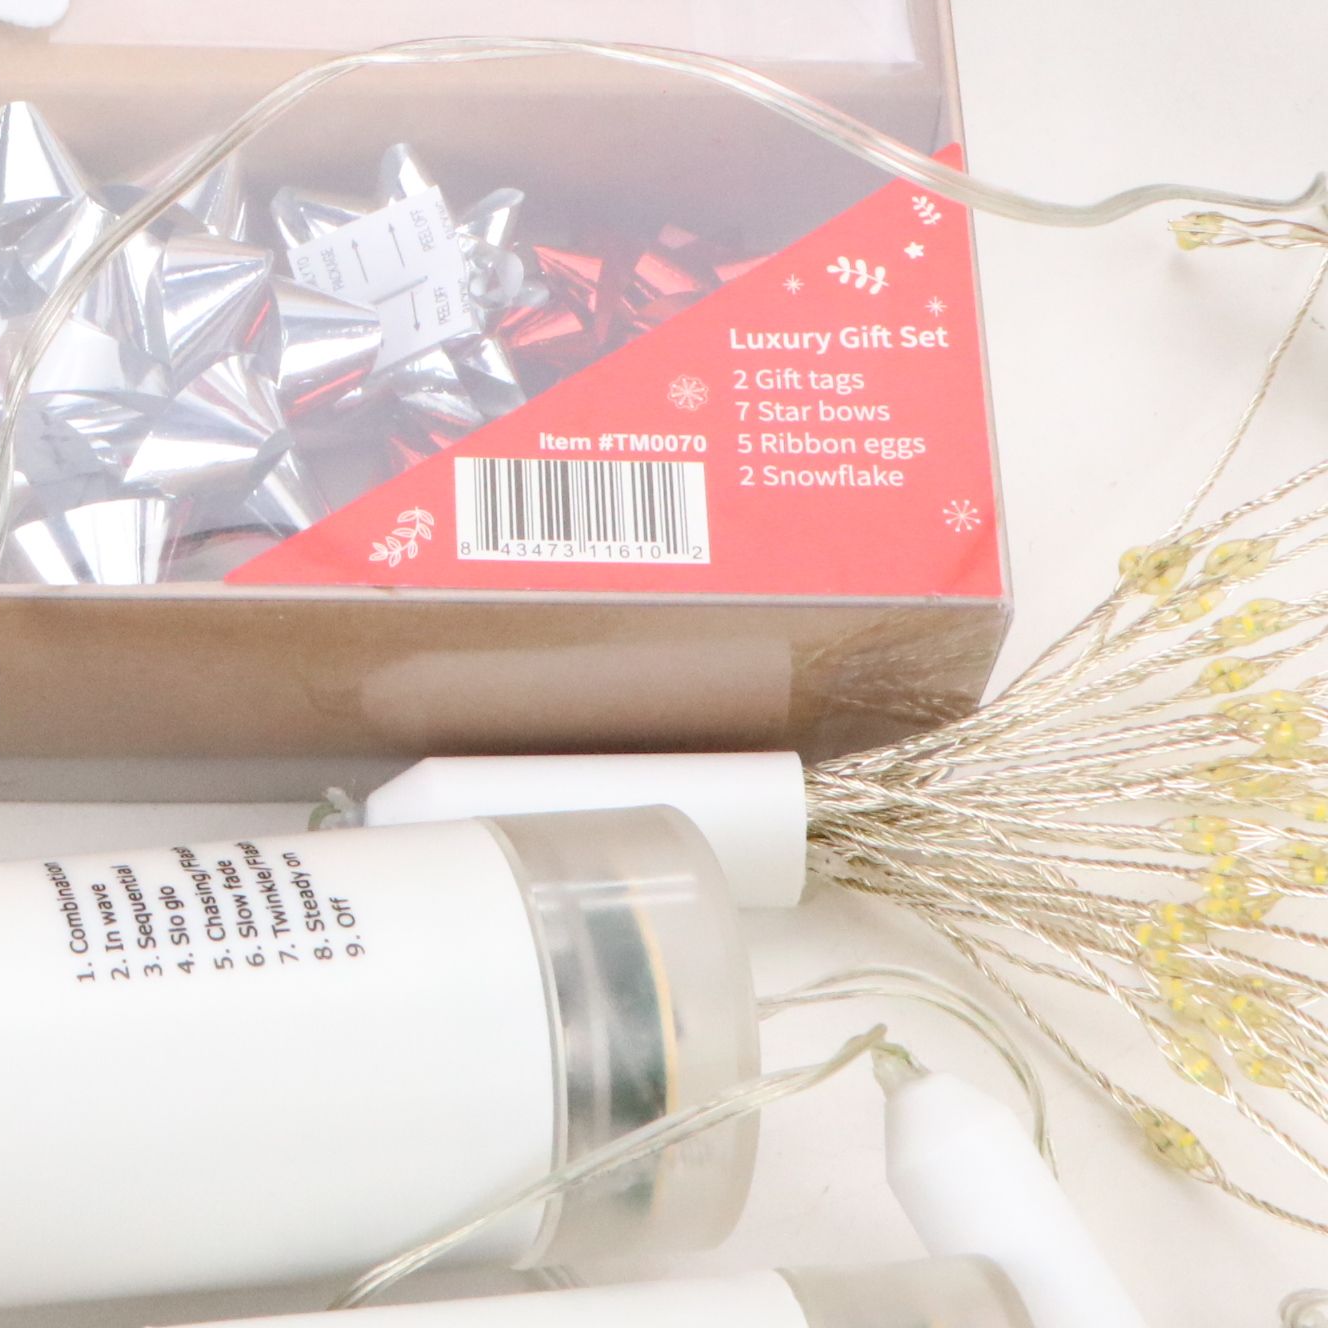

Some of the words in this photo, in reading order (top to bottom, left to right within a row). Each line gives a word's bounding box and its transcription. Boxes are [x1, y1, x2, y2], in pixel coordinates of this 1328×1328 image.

[729, 328, 832, 355] Luxury
[839, 324, 893, 349] Gift
[900, 325, 949, 348] Set
[733, 369, 749, 390] 2
[755, 368, 803, 390] Gift
[808, 370, 865, 395] tags
[735, 401, 751, 422] 7
[758, 401, 812, 422] Star
[819, 400, 891, 422] bows
[539, 432, 592, 450] Item
[598, 433, 707, 452] #TM0070
[737, 433, 753, 455] 5
[761, 432, 857, 454] Ribbon
[864, 436, 926, 460] eggs
[739, 465, 755, 486] 2
[763, 464, 904, 487] Snowflake
[461, 541, 472, 556] 8
[500, 542, 575, 558] 43473
[590, 544, 662, 560] 11610
[692, 545, 703, 560] 2
[282, 851, 301, 868] on
[216, 859, 243, 891] fade
[43, 862, 89, 954] Combination
[91, 882, 118, 926] wave
[110, 864, 157, 950] Sequential
[158, 885, 185, 911] glo
[291, 871, 325, 932] Steady
[232, 894, 258, 939] Slow
[329, 896, 356, 928] Off
[105, 930, 124, 952] In
[169, 915, 190, 946] Slo
[246, 945, 266, 968] 6.
[278, 943, 299, 965] 7.
[313, 937, 333, 961] 8.
[345, 934, 366, 958] 9.
[111, 958, 131, 981] 2.
[143, 955, 163, 978] 3.
[177, 952, 195, 974] 4.
[214, 948, 234, 971] 5.
[77, 961, 95, 983] 1.
